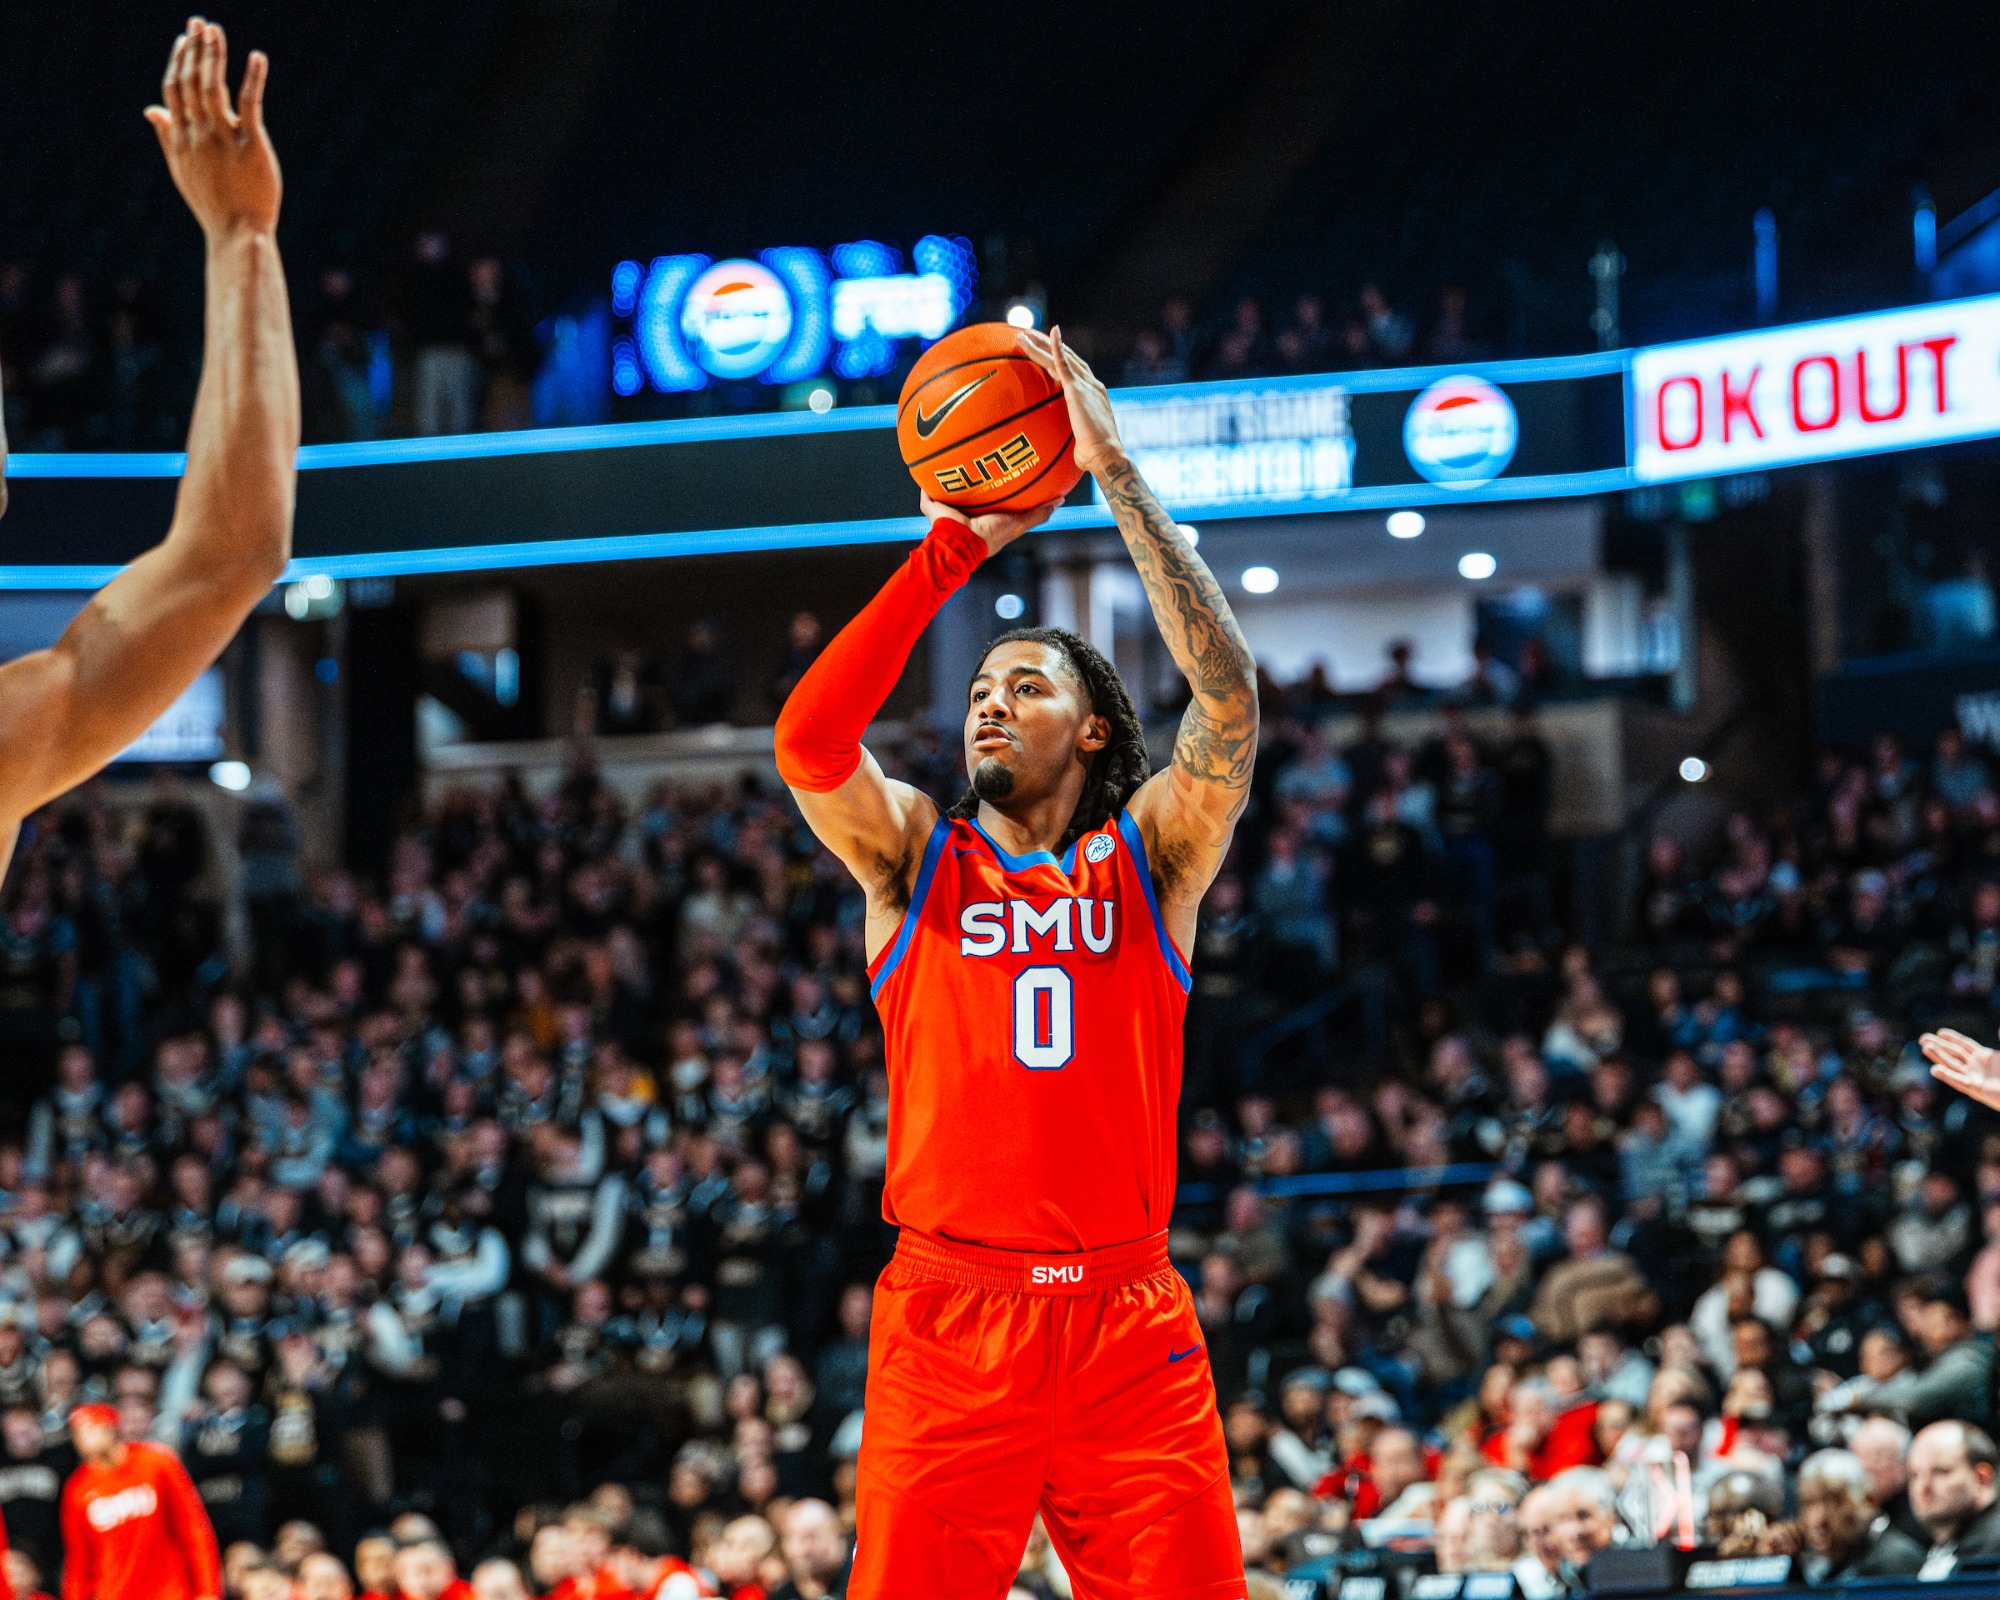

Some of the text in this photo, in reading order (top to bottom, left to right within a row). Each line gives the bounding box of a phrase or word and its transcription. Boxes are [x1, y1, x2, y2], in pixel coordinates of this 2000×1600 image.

[1657, 336, 1957, 452] OK OUT
[934, 431, 1036, 494] ELITE
[960, 897, 1114, 957] SMU
[1012, 964, 1075, 1071] 0
[1032, 1265, 1083, 1284] SMU
